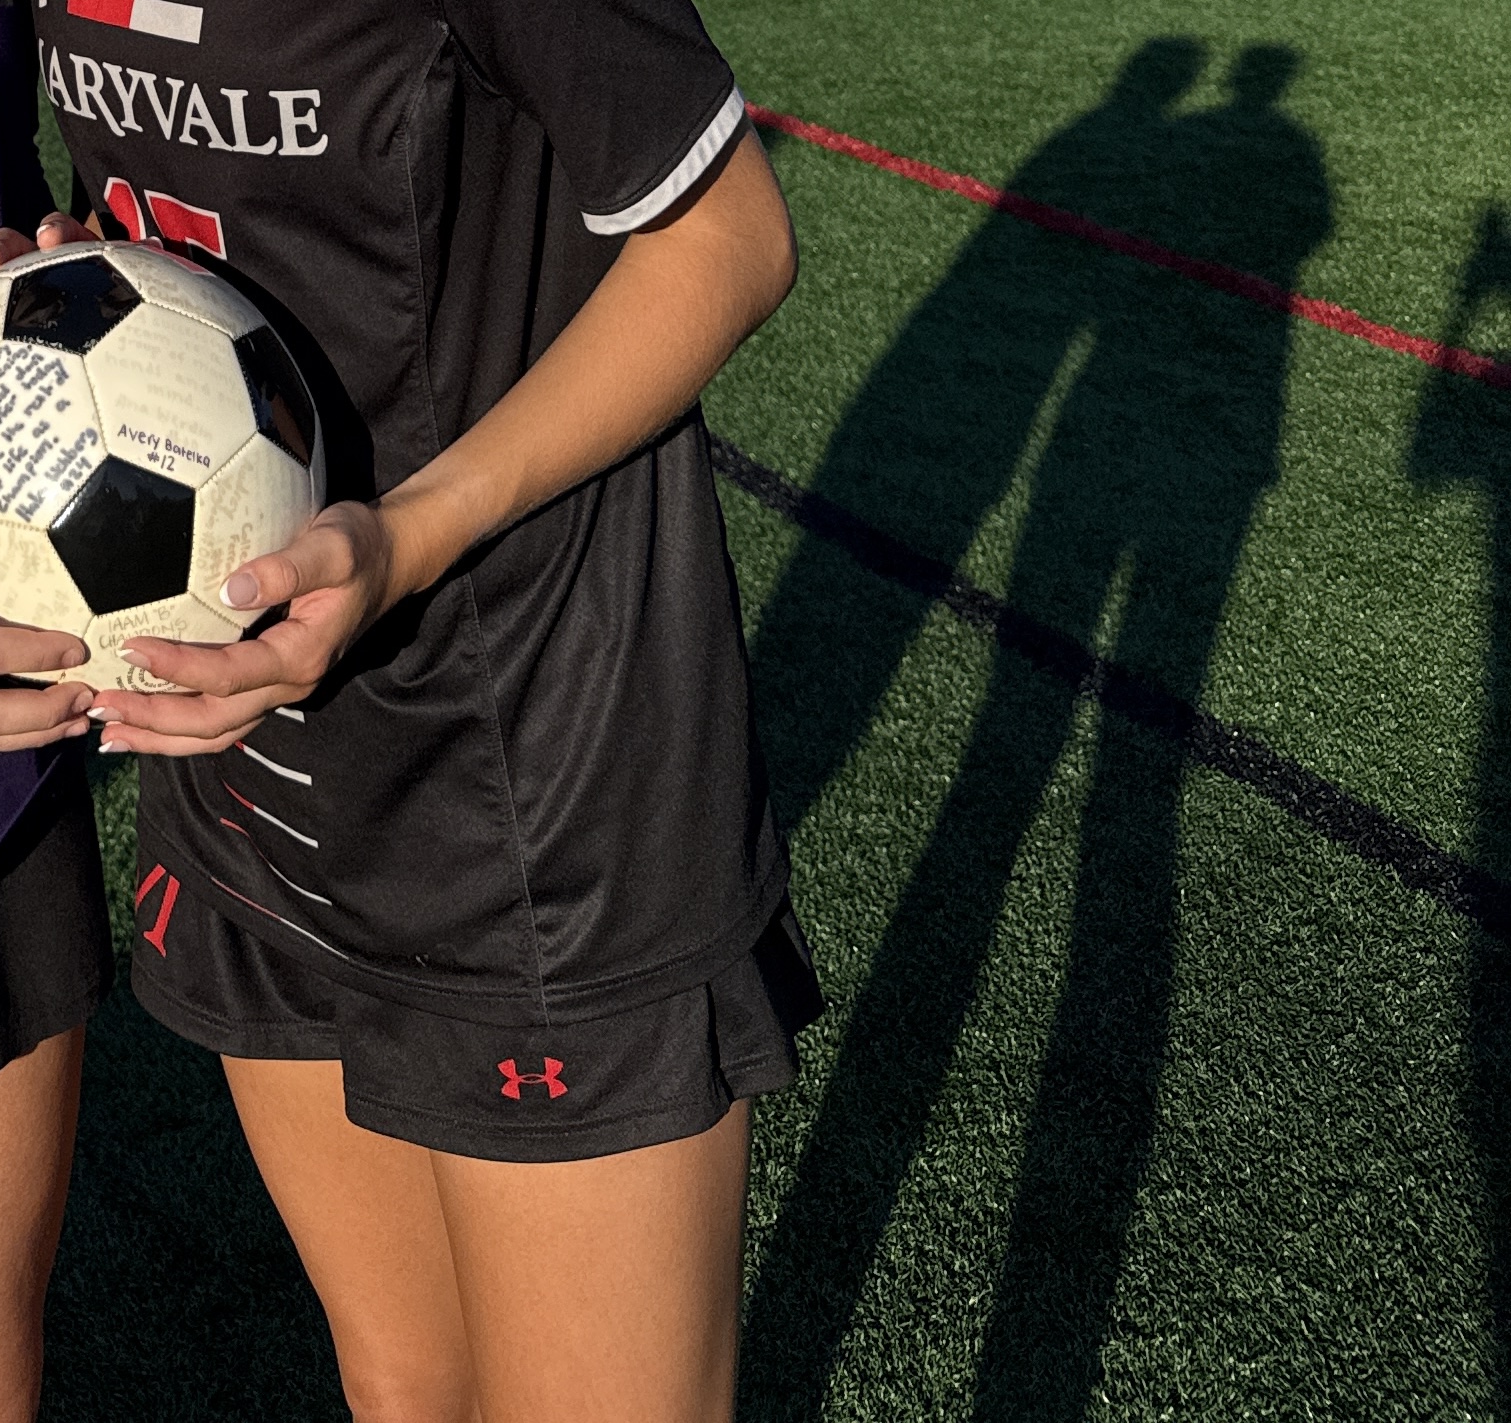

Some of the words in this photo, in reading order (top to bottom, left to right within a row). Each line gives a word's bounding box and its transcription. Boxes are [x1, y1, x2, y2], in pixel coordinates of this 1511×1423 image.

[38, 38, 328, 156] ARYVALE
[117, 424, 160, 450] Avery
[147, 451, 175, 471] #12
[108, 611, 150, 632] IAAM
